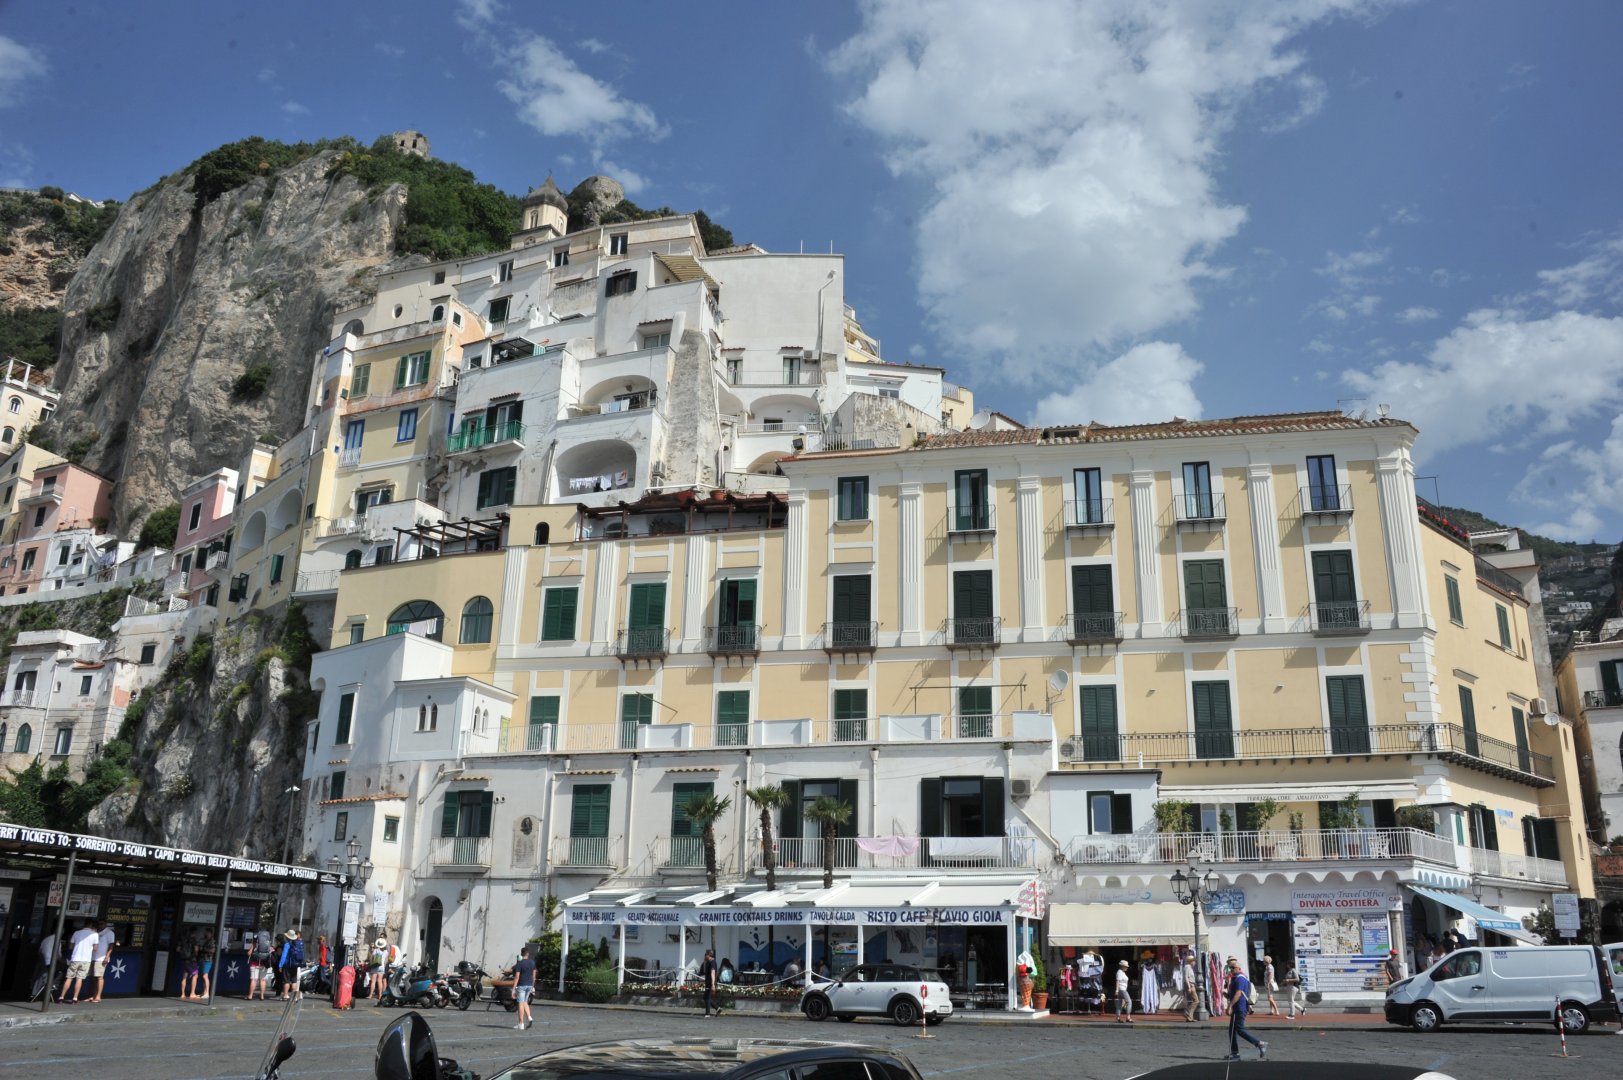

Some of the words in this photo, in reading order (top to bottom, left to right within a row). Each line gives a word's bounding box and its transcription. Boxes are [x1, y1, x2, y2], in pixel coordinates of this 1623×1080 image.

[0, 826, 19, 839] RRY
[21, 829, 55, 845] TICKETS
[57, 834, 72, 847] TO:
[75, 837, 117, 853] SORRENTO
[123, 844, 147, 857] ISCHIA
[154, 849, 175, 861] CAPRI
[181, 853, 206, 865] GROTTA
[208, 857, 228, 868] DELLO
[229, 859, 261, 872] SMERALDO
[264, 864, 289, 876] SALERNO
[292, 868, 318, 880] POSITANO
[1292, 891, 1336, 900] Interagency
[1336, 889, 1362, 898] Travel
[1363, 889, 1385, 900] Office
[1299, 899, 1332, 908] DIVINA
[1335, 899, 1379, 907] COSTIERA
[572, 911, 583, 921] BAR
[589, 912, 600, 921] THE
[601, 911, 616, 921] JUICE
[627, 912, 646, 921] GELATO
[699, 912, 731, 922] GRANITE
[733, 911, 772, 922] COCKTAILS
[774, 911, 803, 921] DRINKS
[810, 911, 833, 921] TAVOLA
[835, 911, 856, 921] CALDA
[867, 911, 897, 923] RISTO
[900, 910, 929, 923] CAFE'
[932, 910, 969, 923] FLAVIO
[972, 910, 1002, 923] GIOIA
